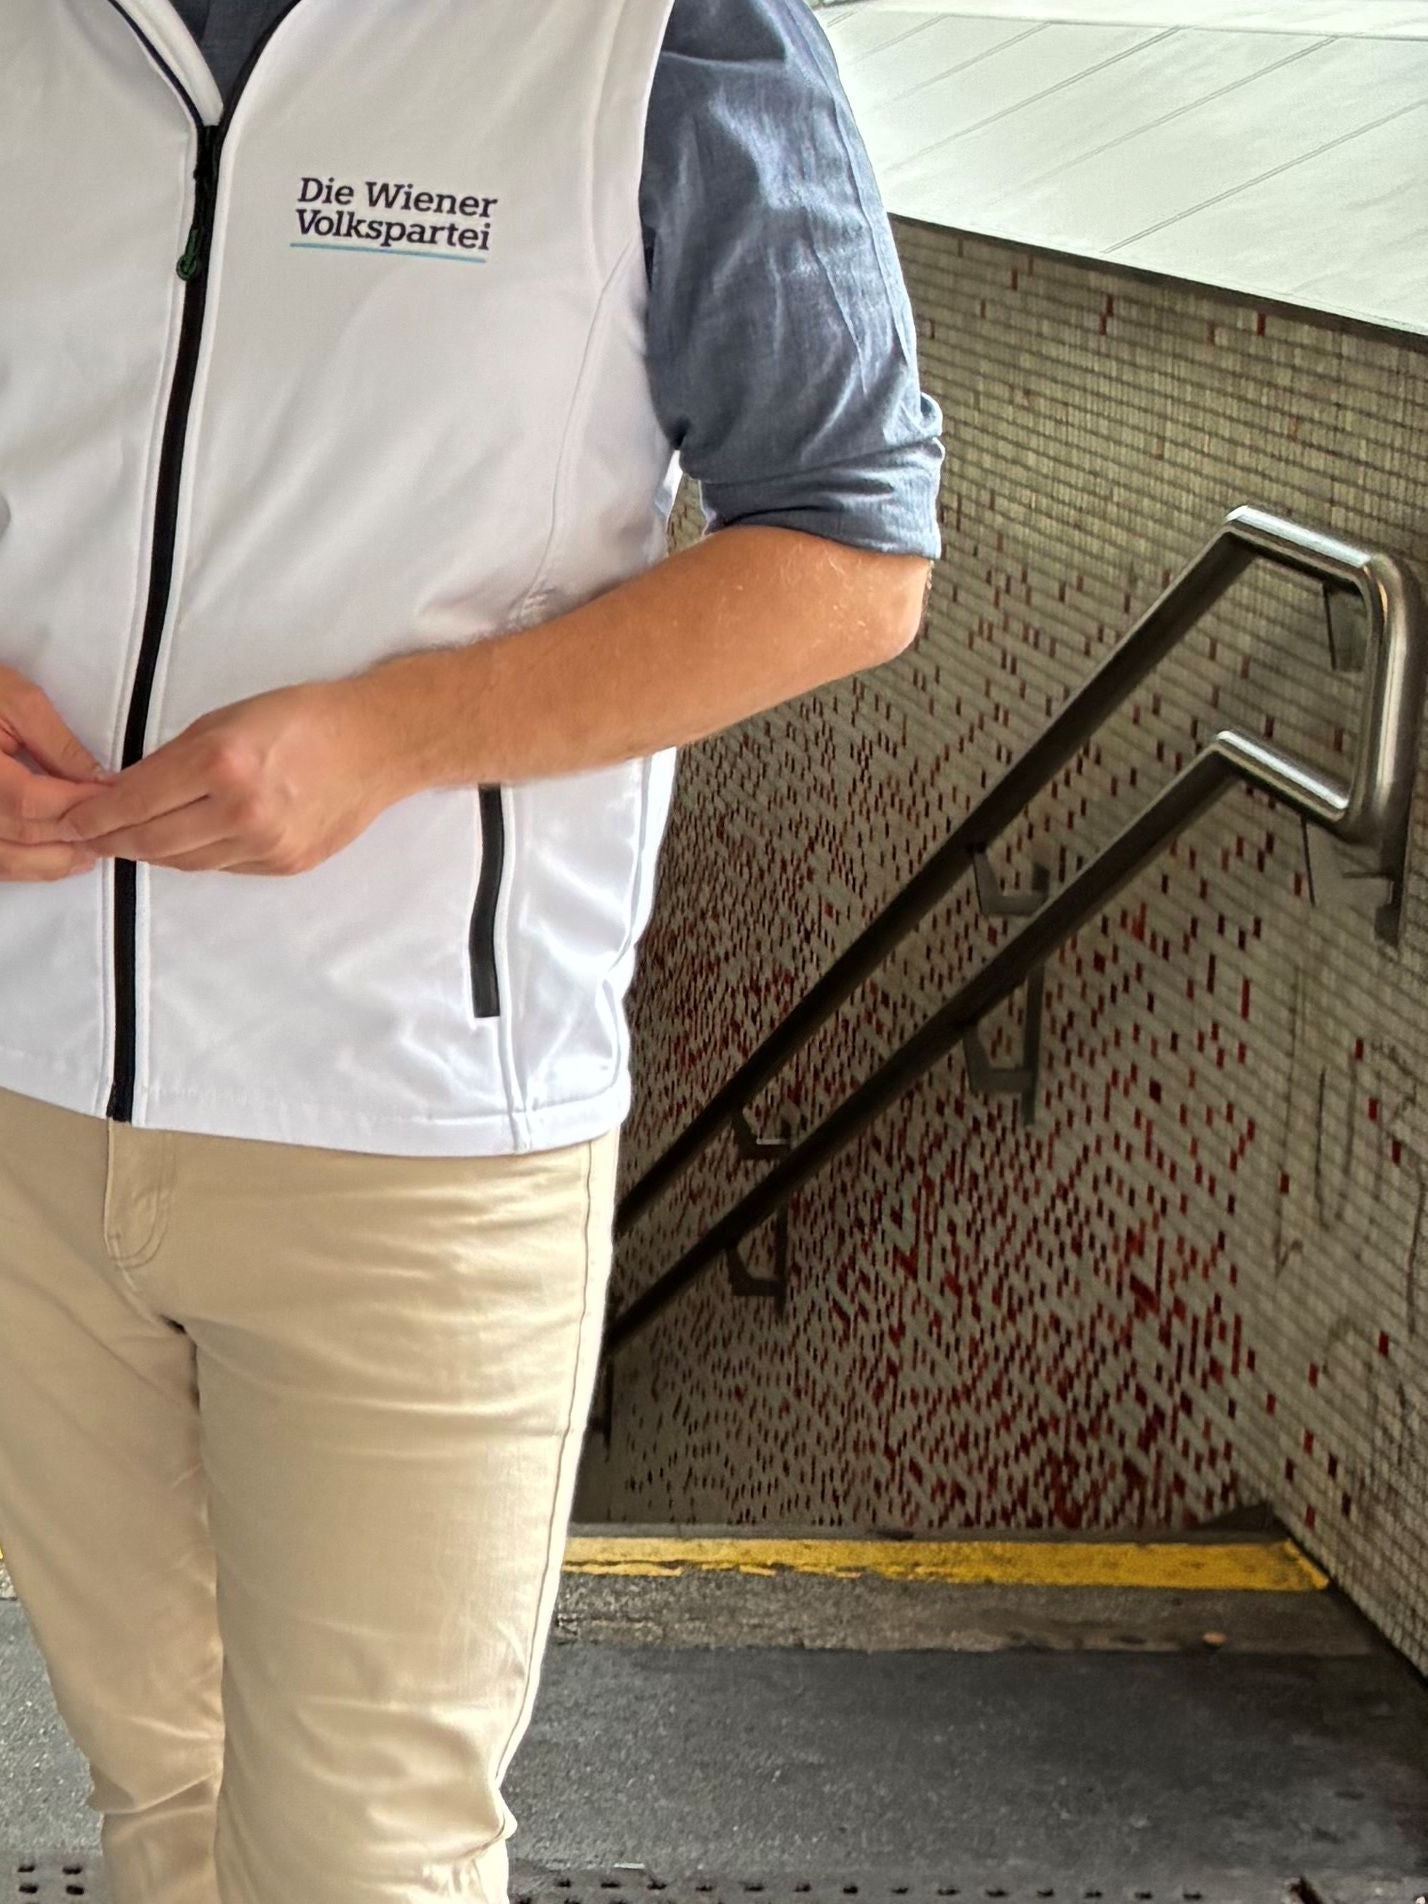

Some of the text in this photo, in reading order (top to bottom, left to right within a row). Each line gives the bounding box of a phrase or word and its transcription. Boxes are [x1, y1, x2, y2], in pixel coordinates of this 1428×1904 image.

[297, 177, 497, 218] Die Wiener
[295, 208, 491, 250] Volkspartei
